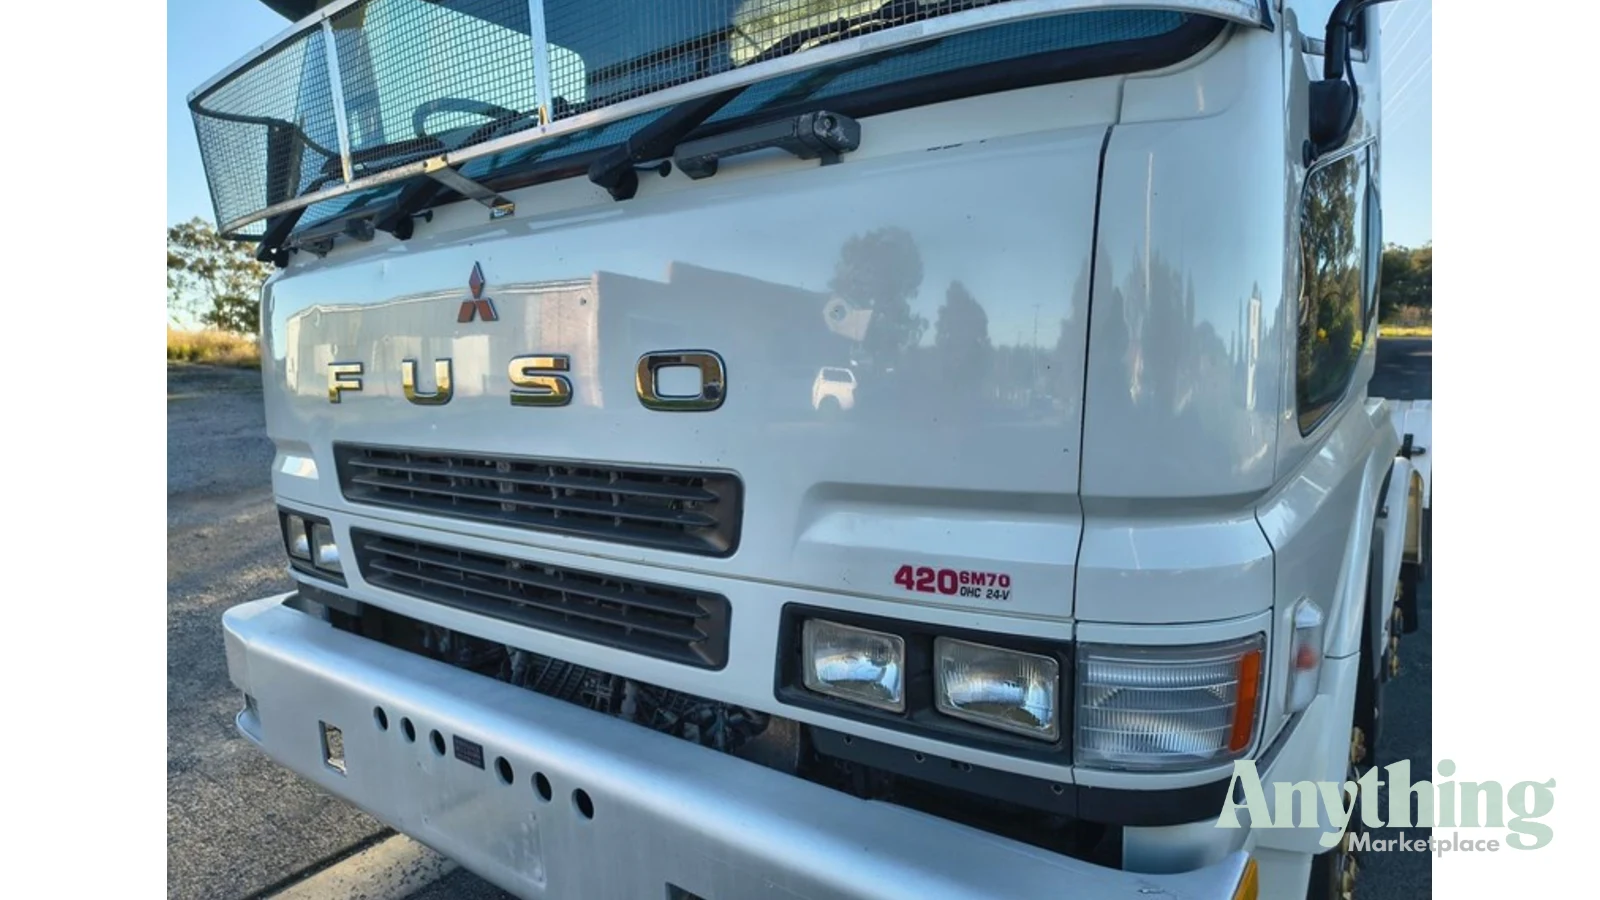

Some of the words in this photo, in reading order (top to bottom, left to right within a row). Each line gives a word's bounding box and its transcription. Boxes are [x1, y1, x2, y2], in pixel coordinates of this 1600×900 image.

[327, 348, 728, 413] FUSO
[894, 564, 958, 596] 420
[959, 570, 1011, 588] 6M70
[960, 586, 982, 599] OHC
[985, 588, 1011, 601] 24-V
